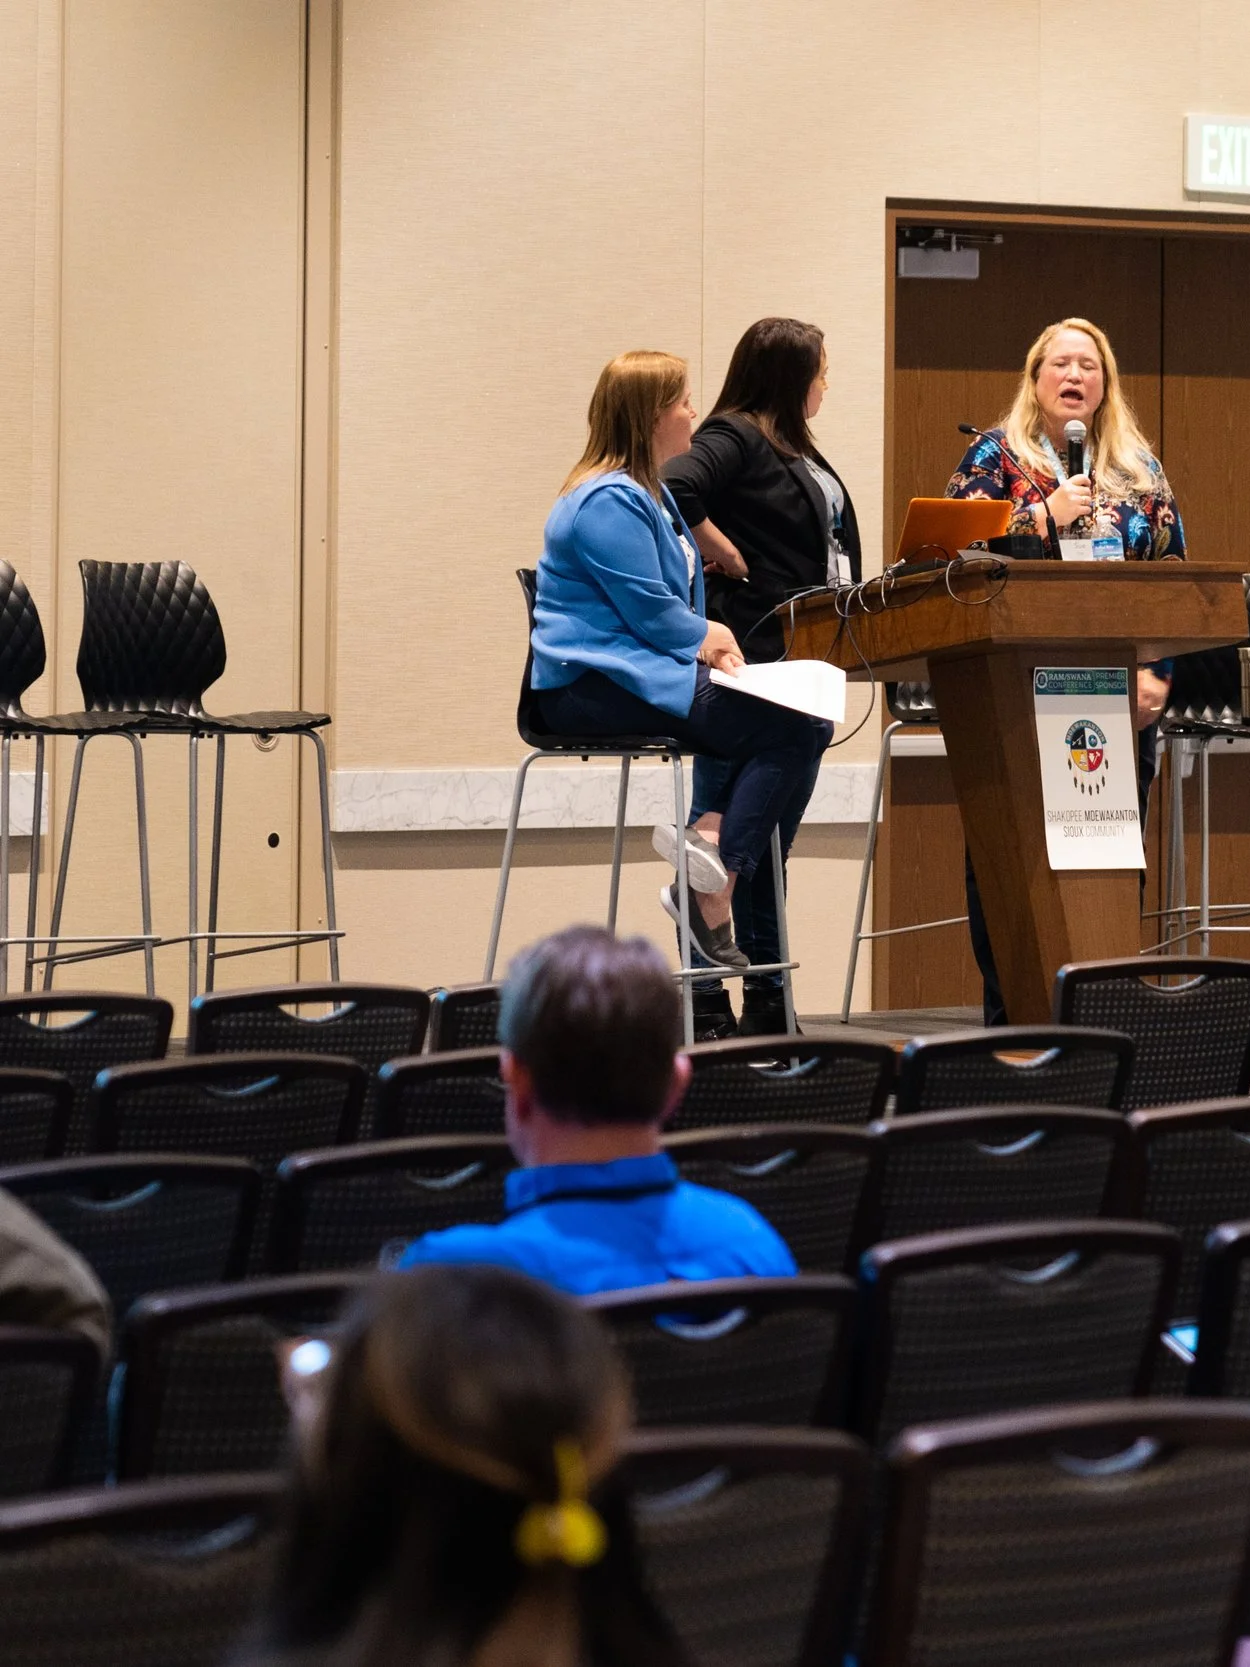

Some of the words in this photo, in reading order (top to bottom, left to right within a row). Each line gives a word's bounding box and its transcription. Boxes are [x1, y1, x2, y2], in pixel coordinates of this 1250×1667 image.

[1048, 673, 1092, 681] RAM/SWANA
[1096, 672, 1126, 680] PREMIER
[1048, 681, 1093, 689] CONFERENCE
[1047, 810, 1083, 823] SHAKOPEE
[1084, 809, 1138, 822] MDEWAKANTON
[1063, 825, 1084, 838] SIOUX
[1085, 825, 1125, 838] COMMUNITY
